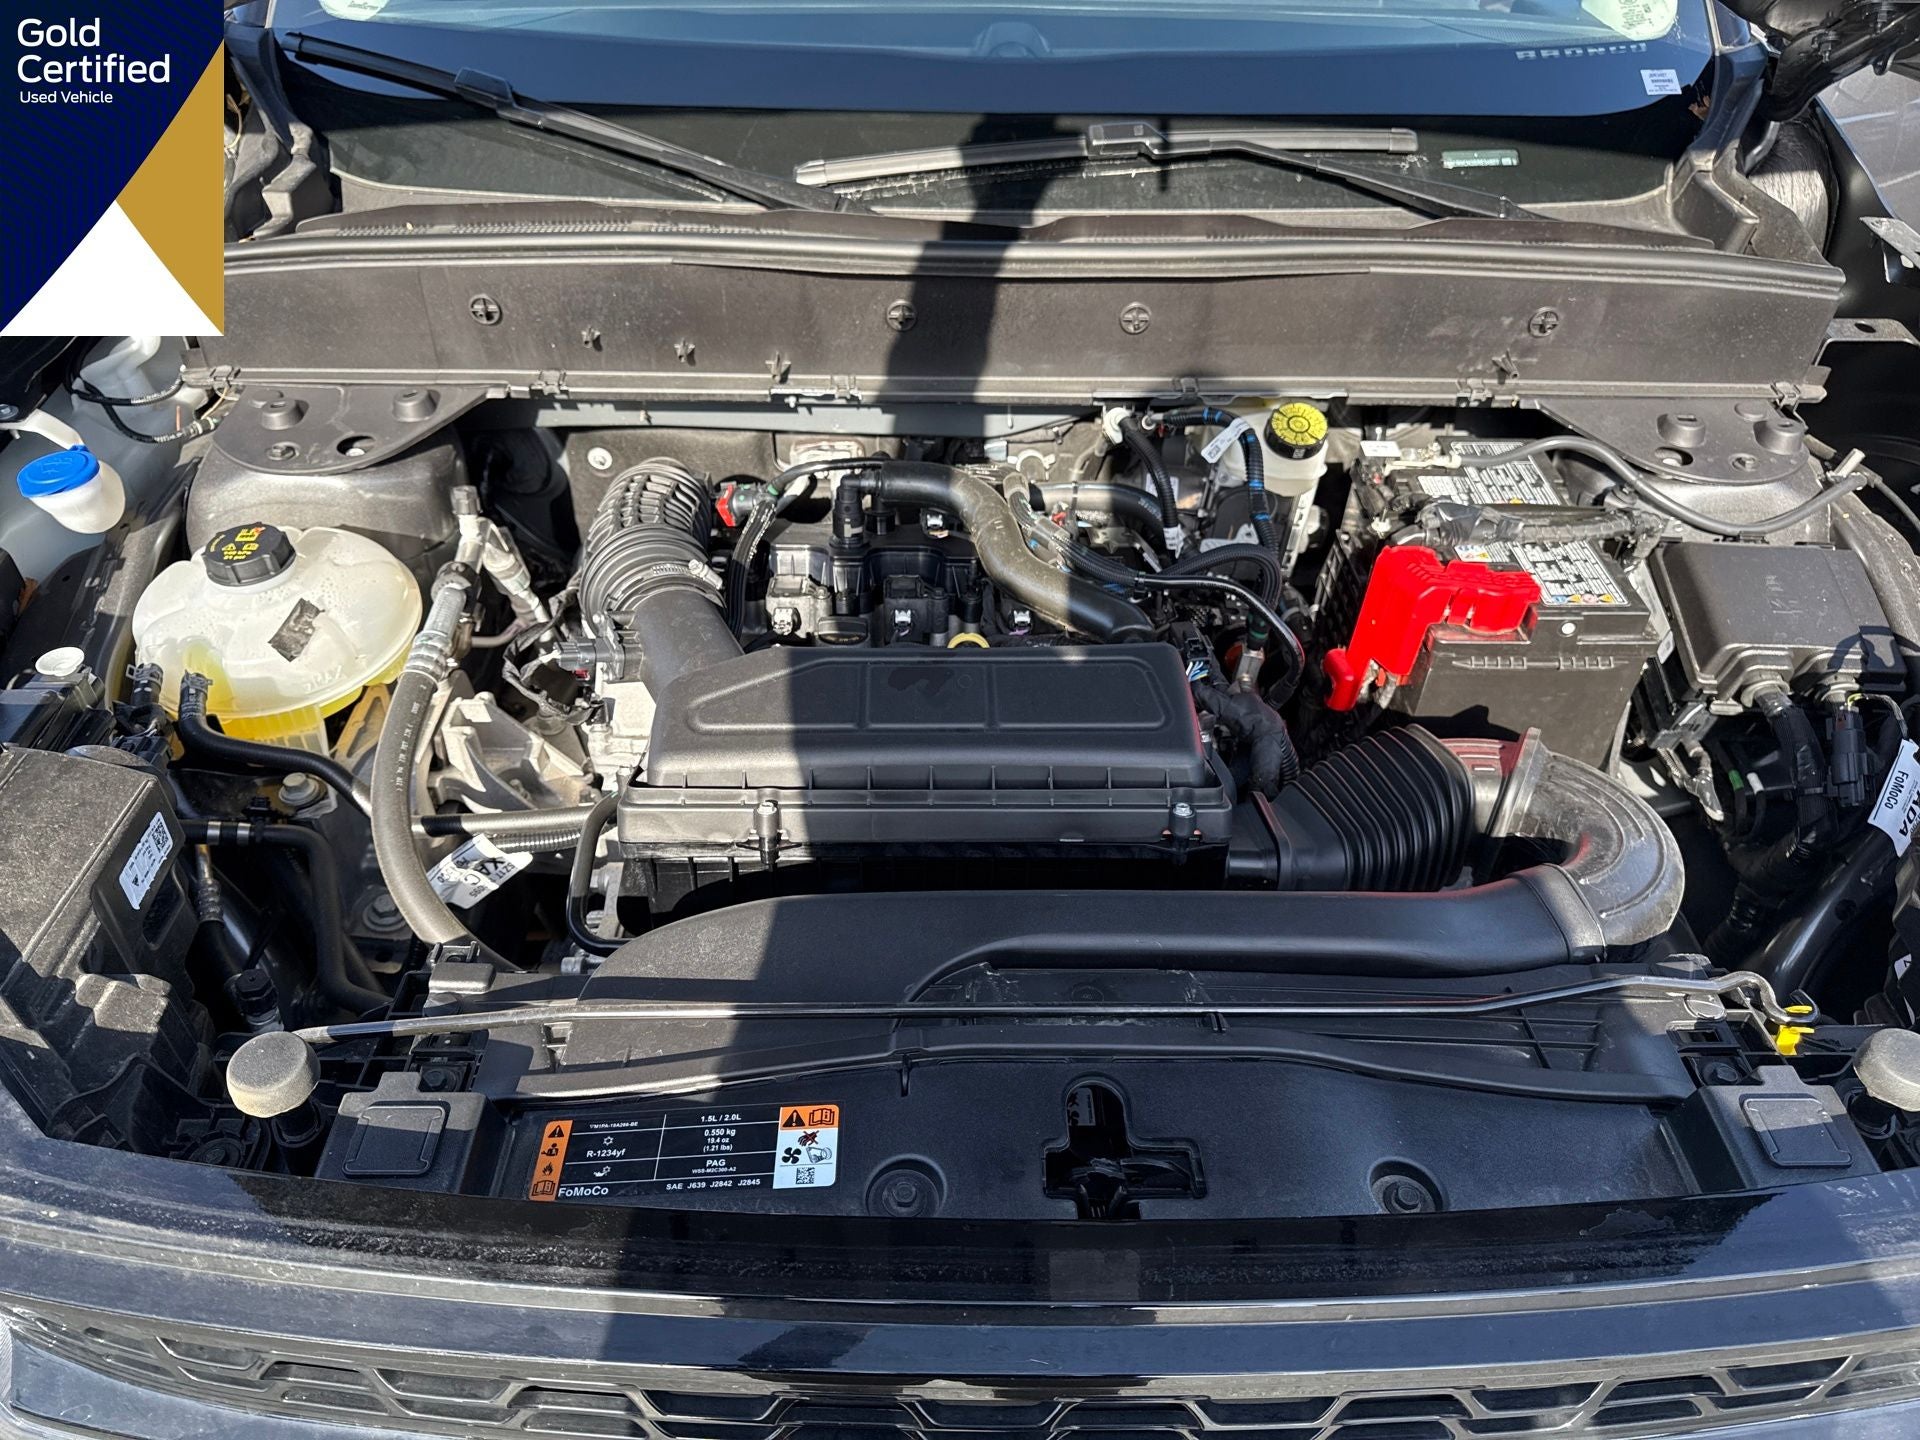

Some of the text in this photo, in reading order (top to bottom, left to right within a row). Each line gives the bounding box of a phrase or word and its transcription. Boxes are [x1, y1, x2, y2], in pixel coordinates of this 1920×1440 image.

[1884, 770, 1909, 809] FoMoCo
[724, 1113, 741, 1121] 2.0L
[704, 1128, 736, 1137] 0.550 kg
[586, 1148, 626, 1158] R-1234yf
[706, 1159, 726, 1167] PAG
[666, 1178, 761, 1190] SAE J639 J2842 J2845
[557, 1186, 609, 1197] FoMoCo
